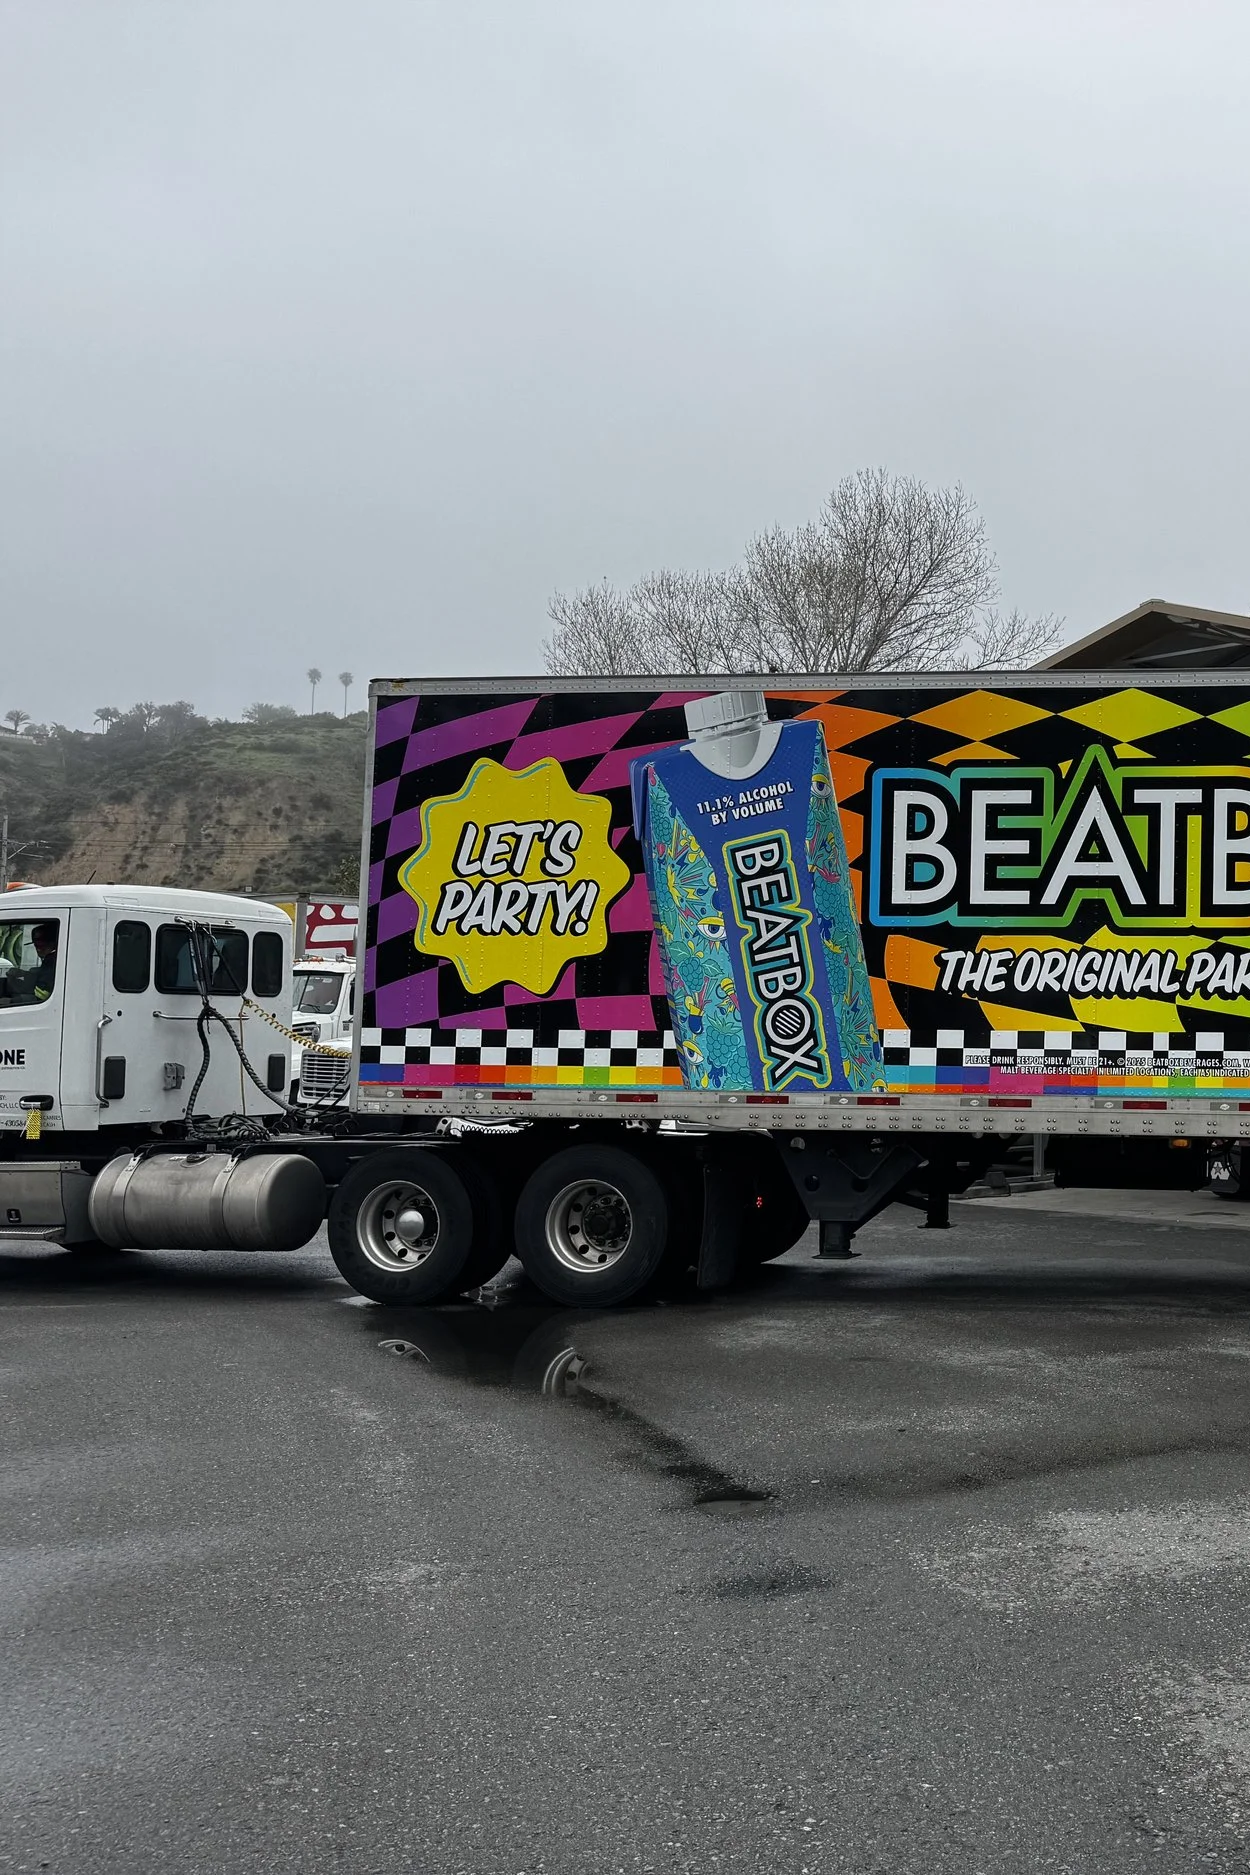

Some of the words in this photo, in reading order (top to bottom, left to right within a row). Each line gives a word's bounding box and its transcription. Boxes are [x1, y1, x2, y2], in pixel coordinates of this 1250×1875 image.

[696, 795, 734, 814] 11.1%
[739, 781, 794, 804] ALCOHOL
[711, 810, 728, 826] BY
[731, 798, 784, 820] VOLUME
[455, 821, 582, 876] LET'S
[434, 881, 599, 934] PARTY!
[734, 841, 819, 1080] BEATBOX
[940, 950, 1017, 993] THE
[1013, 951, 1183, 994] ORIGINAL
[965, 1055, 990, 1064] PLEASE
[992, 1056, 1015, 1065] DRINK
[1016, 1056, 1064, 1065] RESPONSIBLY.
[1066, 1057, 1086, 1066] MUST
[1087, 1057, 1098, 1066] BE
[1127, 1058, 1146, 1067] 2025
[1000, 1066, 1019, 1074] MALT
[1020, 1066, 1058, 1075] BEVERAGE
[1058, 1067, 1095, 1075] SPECIALTY
[1096, 1067, 1105, 1075] IN
[1106, 1068, 1135, 1076] LIMITED
[1180, 1069, 1198, 1077] EACH
[1200, 1069, 1211, 1077] AS
[1212, 1069, 1250, 1077] INDICATED
